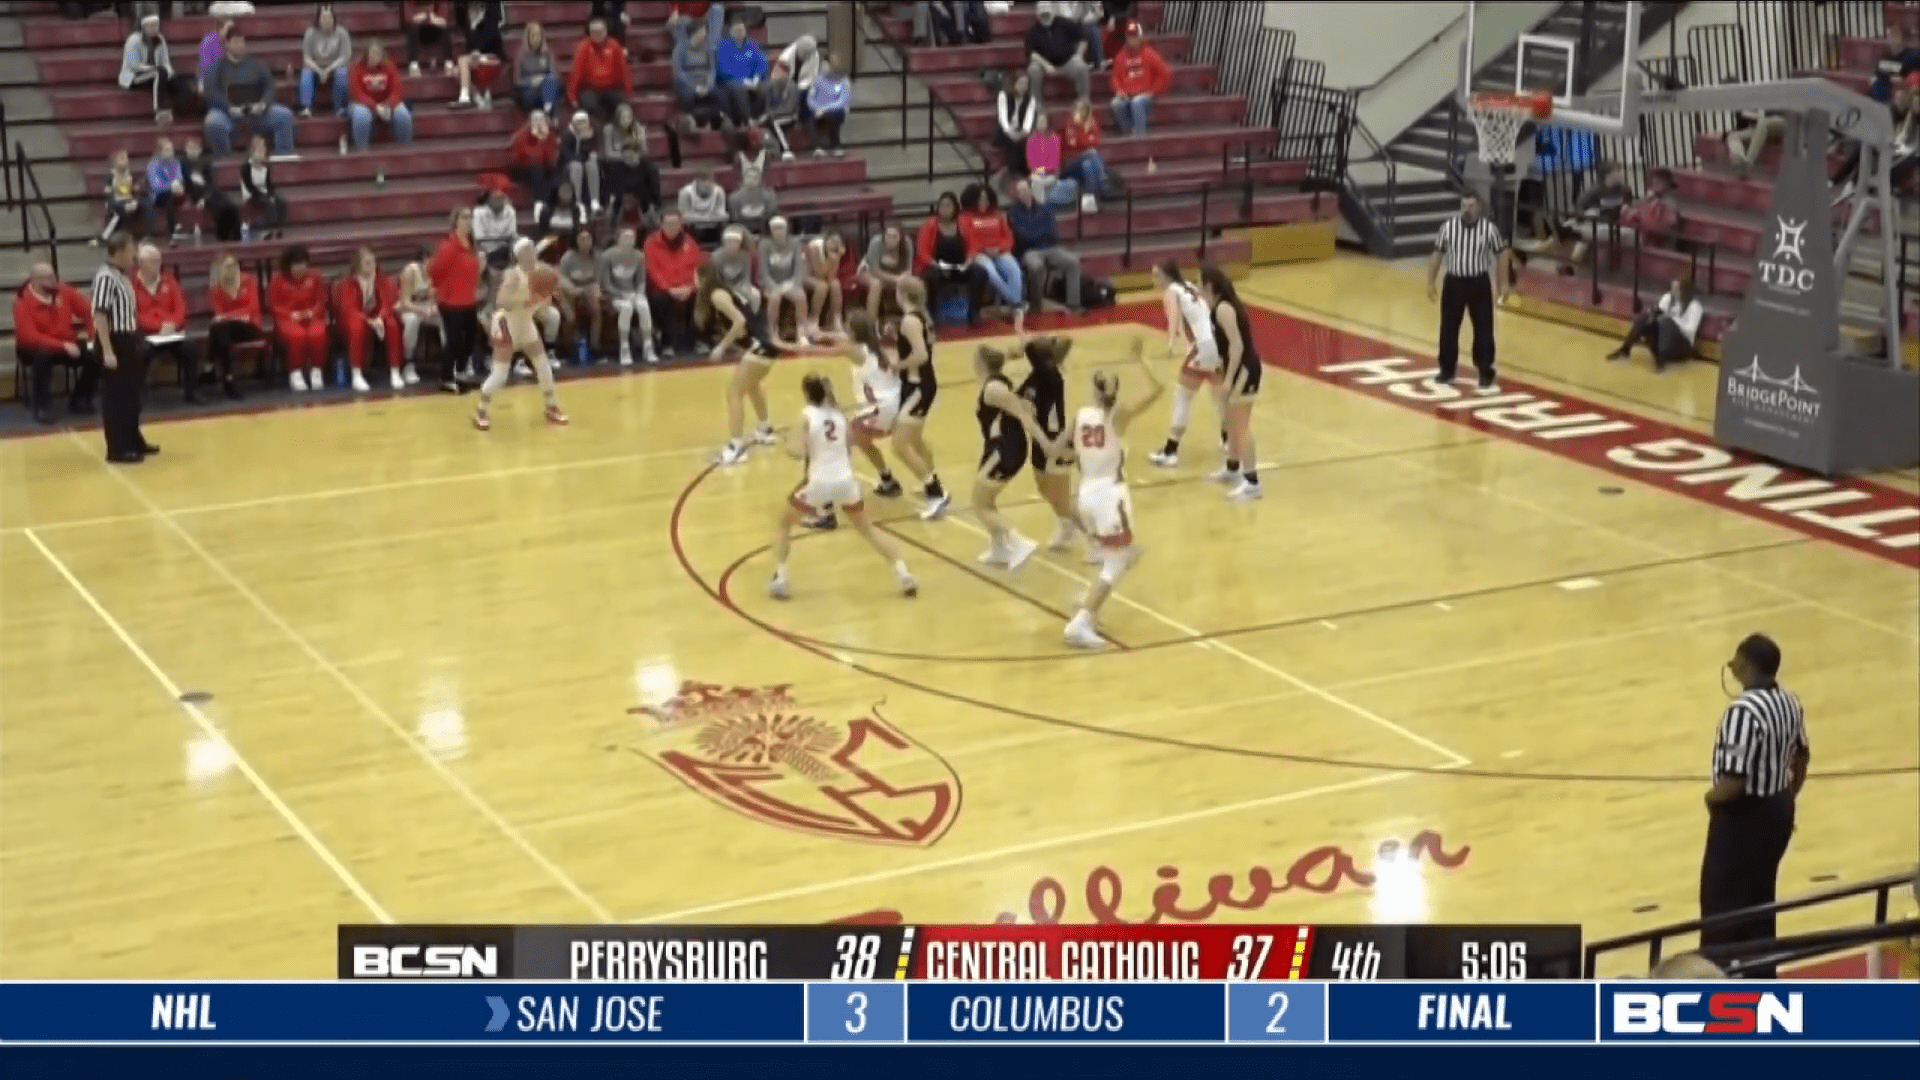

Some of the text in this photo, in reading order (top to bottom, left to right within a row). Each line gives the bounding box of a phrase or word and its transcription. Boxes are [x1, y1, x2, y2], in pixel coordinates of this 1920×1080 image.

[1758, 260, 1815, 292] TDC
[1319, 358, 1635, 439] IRISH
[1727, 376, 1821, 418] BRIDGEPOINT
[823, 419, 838, 442] 2
[1082, 424, 1105, 448] 20
